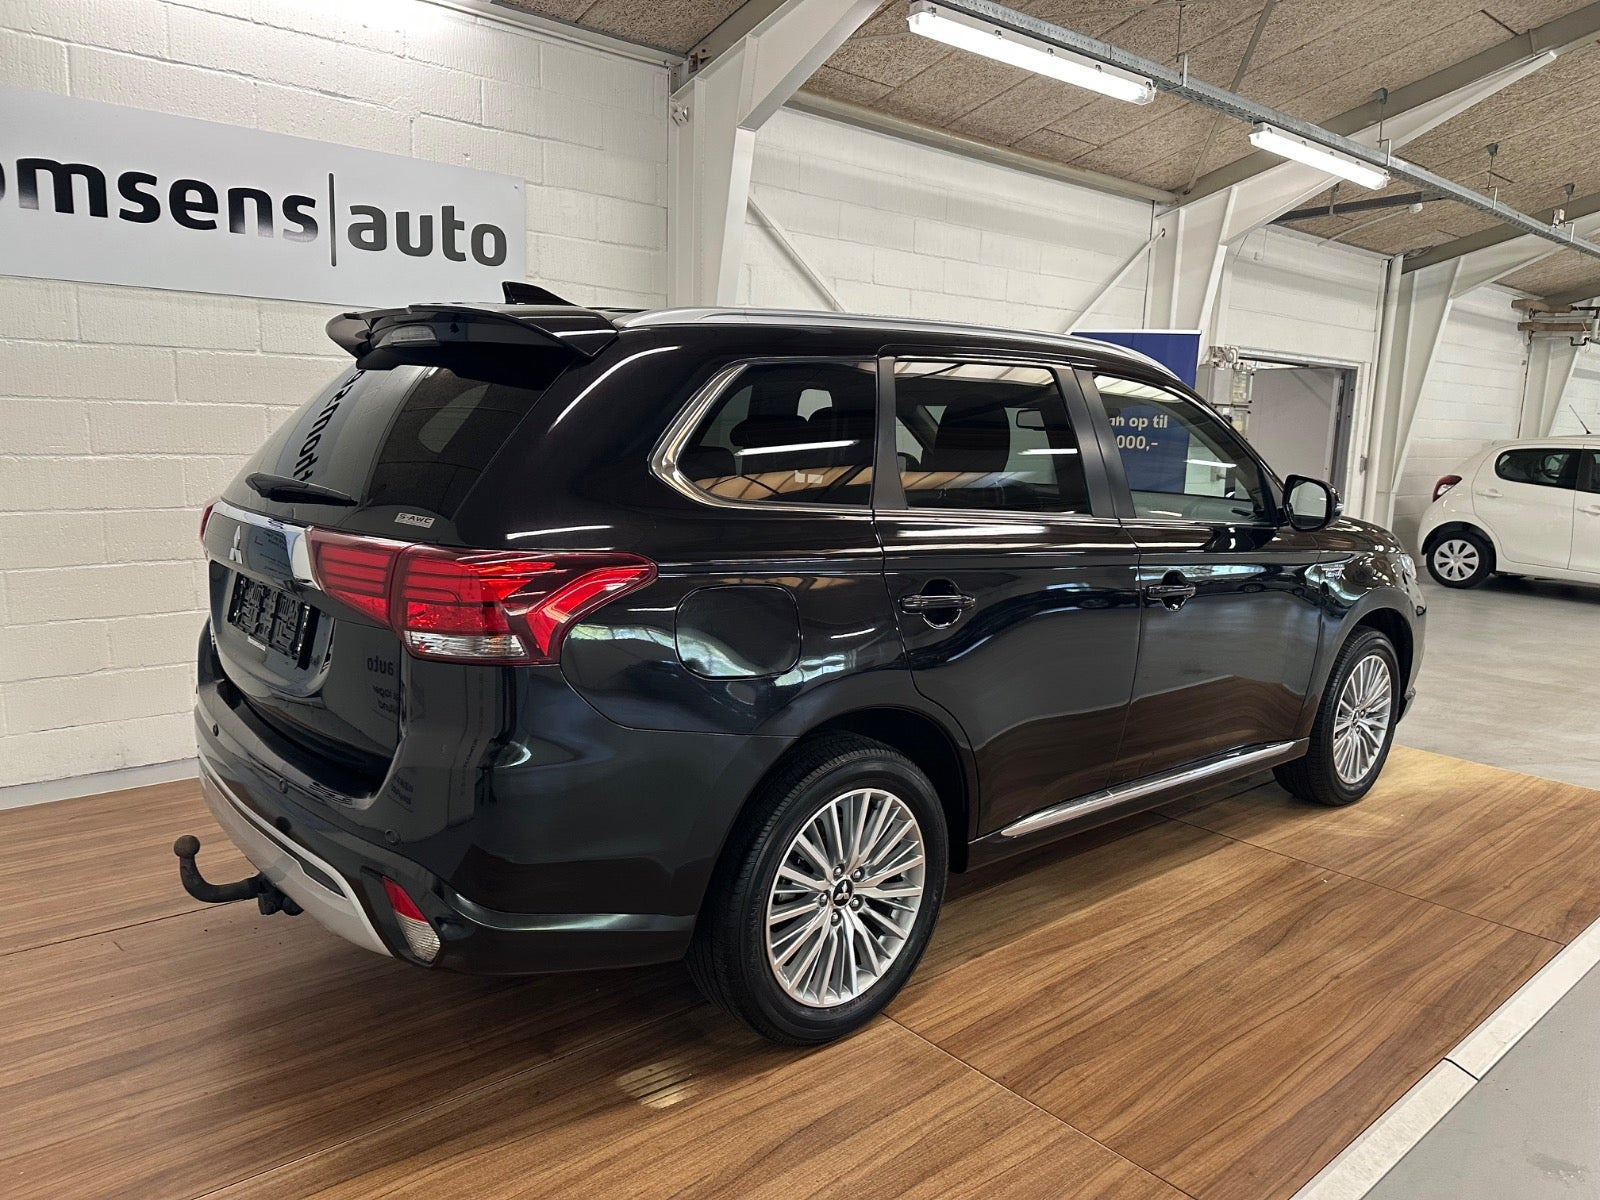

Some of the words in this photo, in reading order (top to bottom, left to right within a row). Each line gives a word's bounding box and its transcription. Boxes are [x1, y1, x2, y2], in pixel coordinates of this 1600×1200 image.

[347, 204, 508, 267] auto
[1129, 417, 1149, 431] op
[1153, 414, 1168, 428] til
